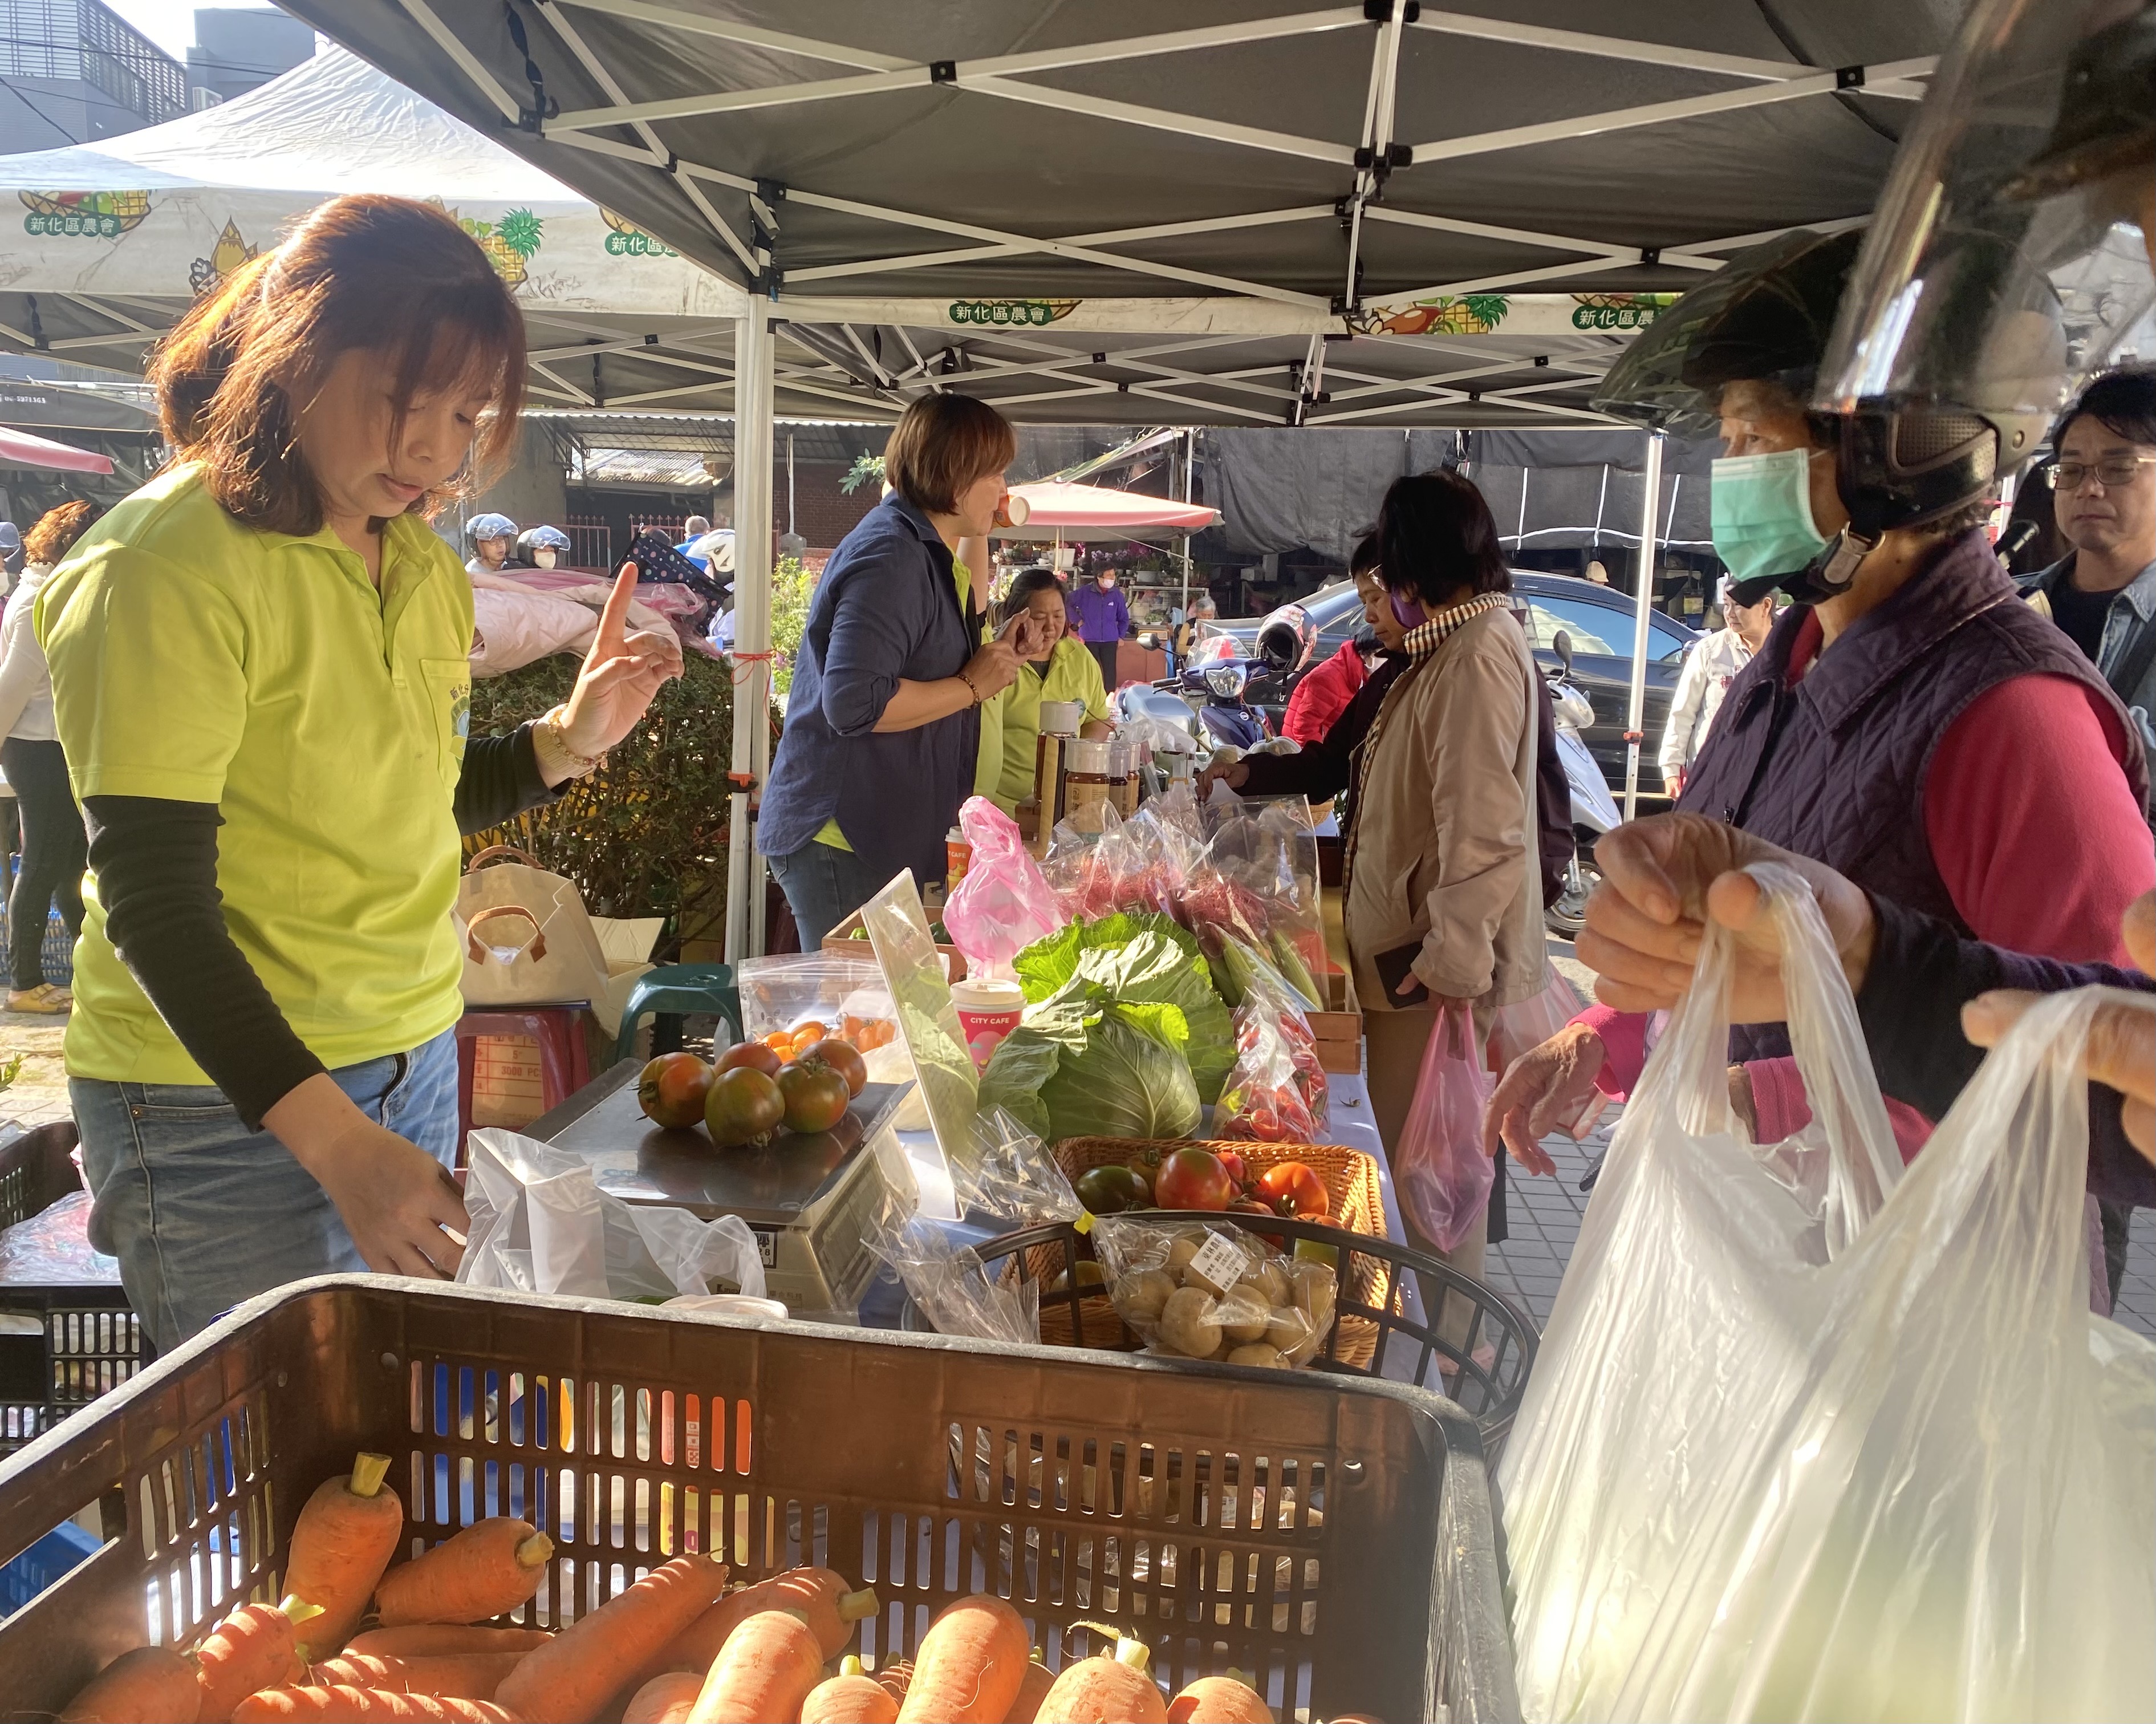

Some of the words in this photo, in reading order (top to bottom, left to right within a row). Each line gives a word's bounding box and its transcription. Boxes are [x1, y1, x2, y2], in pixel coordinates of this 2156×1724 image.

[30, 216, 115, 234] 新化區農會
[956, 305, 1045, 322] 新化區農會
[1579, 309, 1662, 326] 新化區農
[501, 1066, 522, 1076] 3000
[527, 1069, 541, 1077] PC
